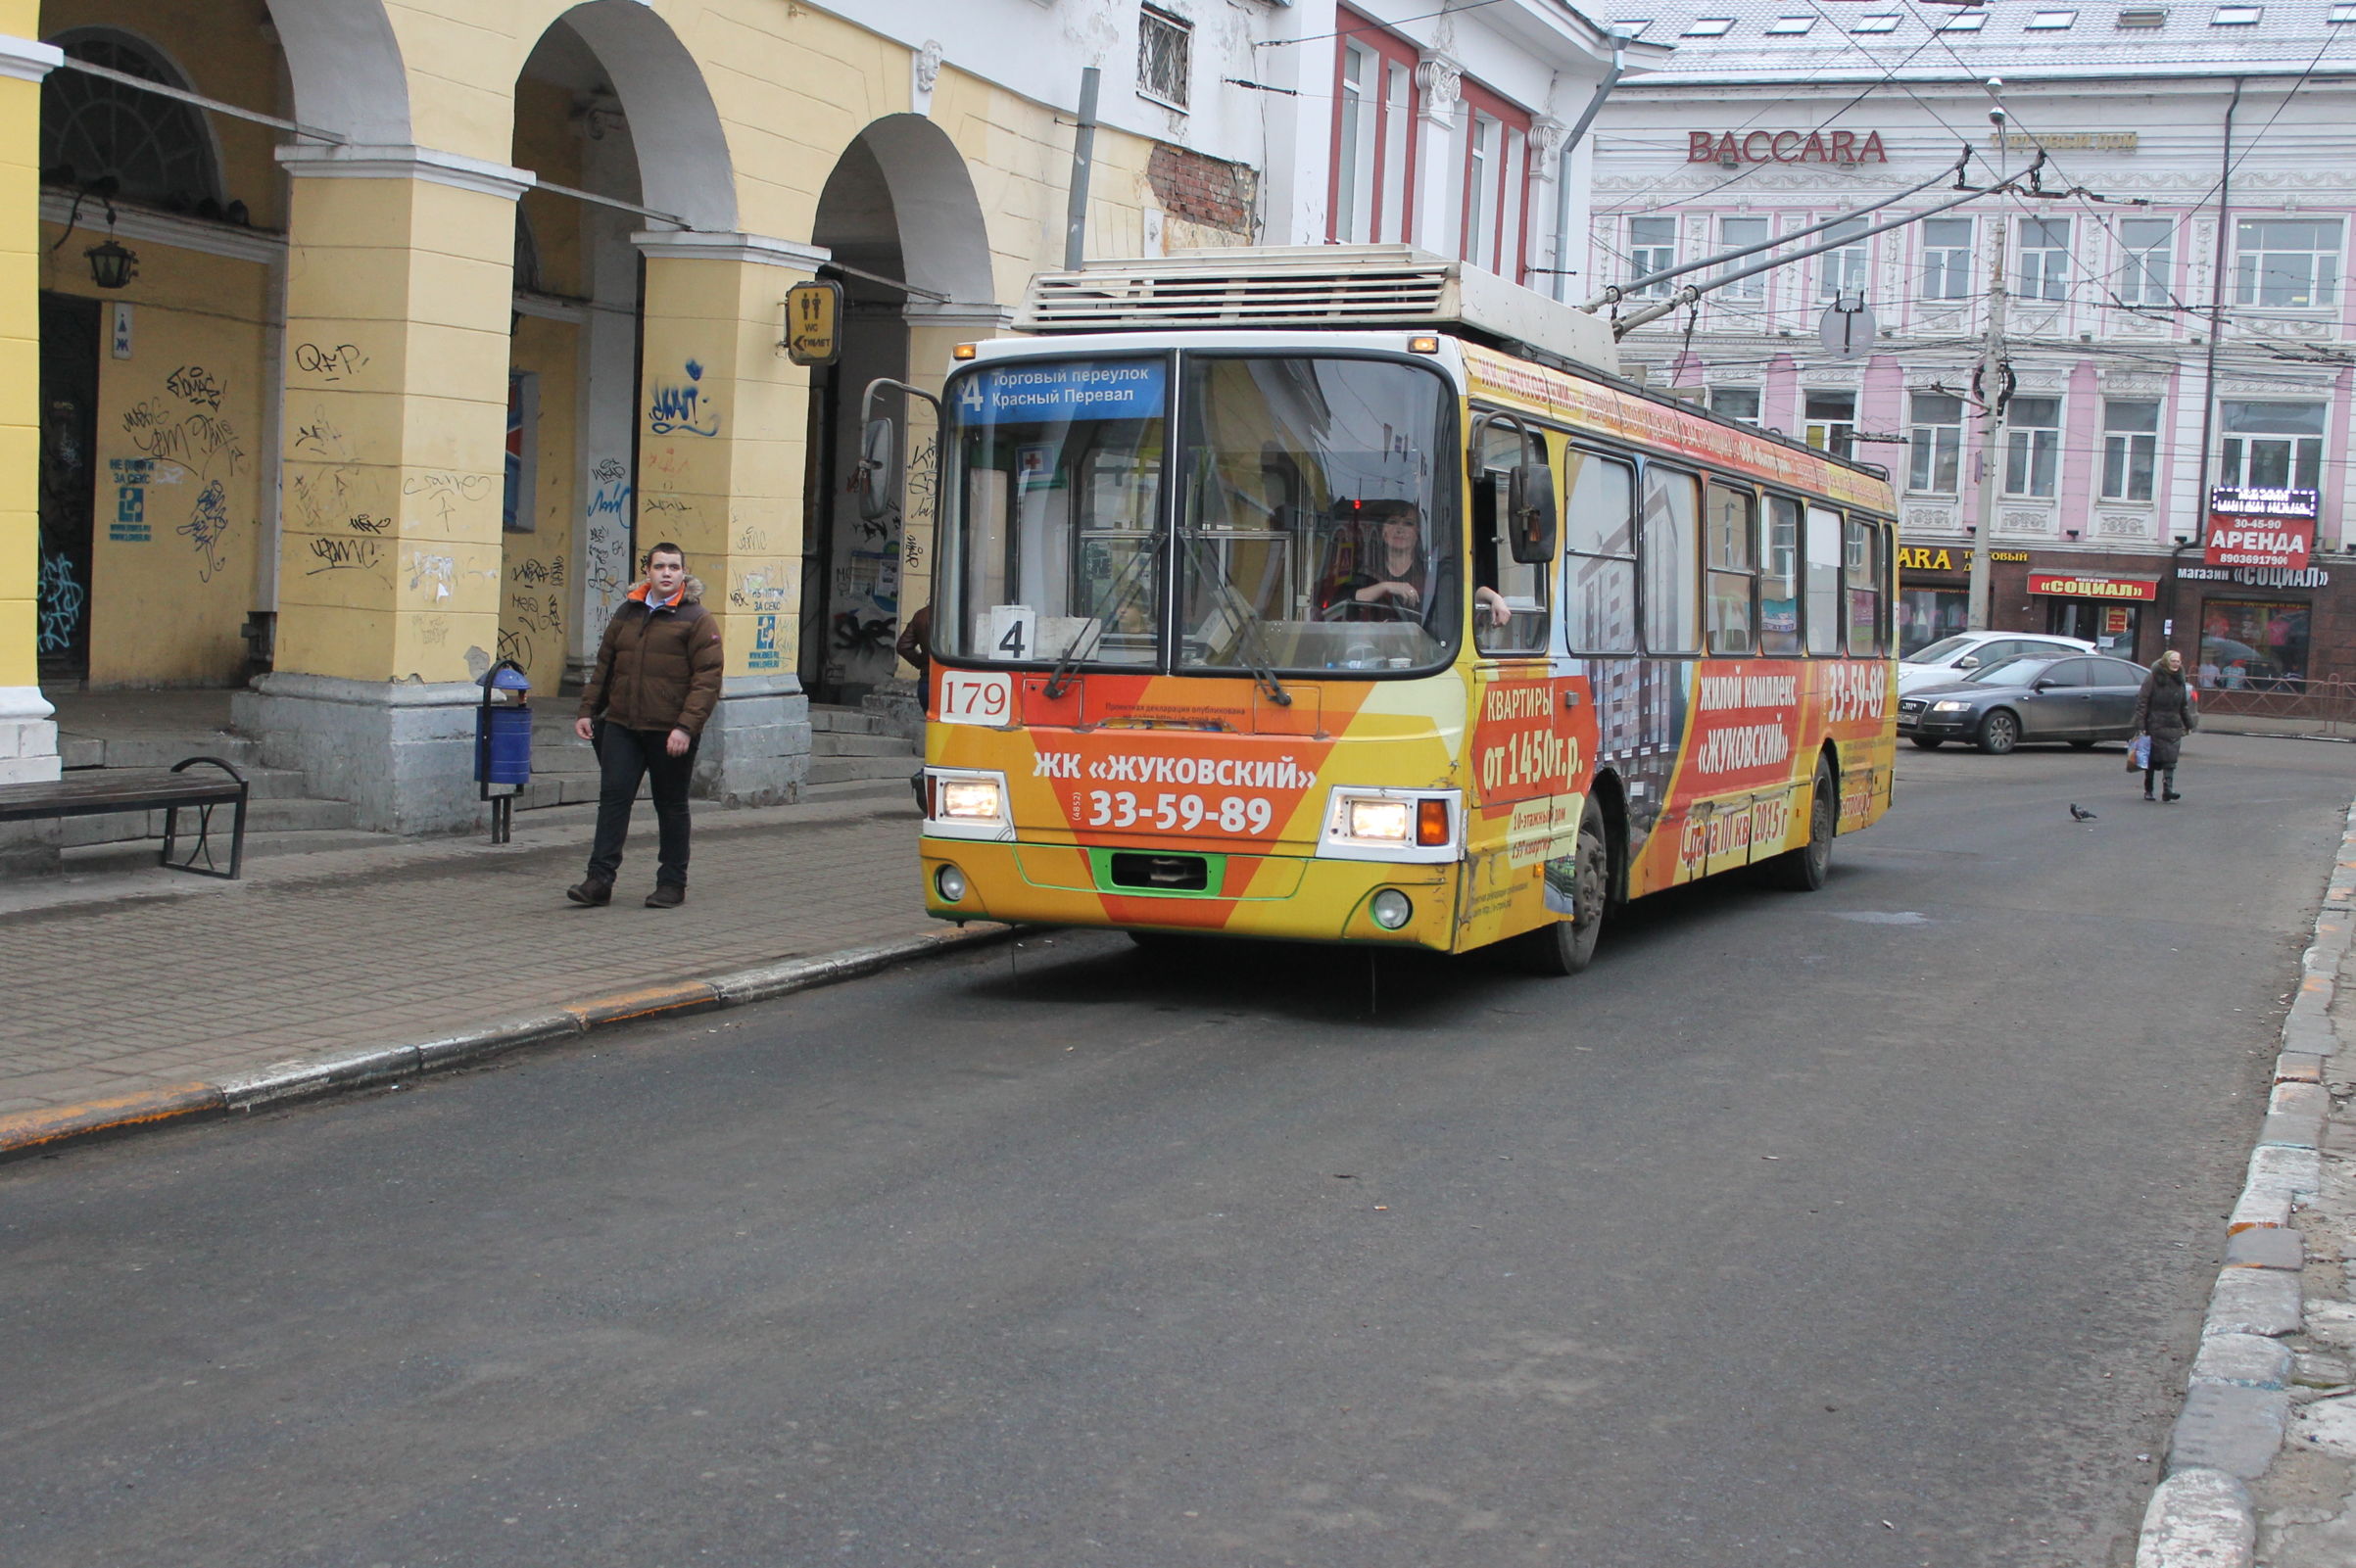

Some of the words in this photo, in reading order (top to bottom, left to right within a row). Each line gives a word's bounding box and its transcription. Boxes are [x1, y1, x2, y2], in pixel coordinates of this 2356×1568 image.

[1687, 130, 1888, 164] BACCARA
[116, 338, 128, 352] Ж
[962, 374, 984, 412] 4
[991, 369, 1067, 389] Торговый
[1072, 368, 1149, 385] переулок
[992, 390, 1060, 409] Красный
[1064, 389, 1134, 406] Перевал
[2235, 519, 2282, 530] 30-45-90
[2210, 530, 2305, 555] АРЕНДА
[2041, 580, 2142, 597] «СОЦИАЛ»
[2177, 567, 2230, 581] магазин
[2234, 566, 2329, 589] «СОЦИАЛ»
[999, 620, 1026, 659] 4
[945, 681, 1007, 716] 179
[1487, 687, 1553, 722] КВАРТИРЫ
[1828, 663, 1885, 723] 33-59-89
[1698, 713, 1789, 775] «ЖУКОВСКИЙ»
[1033, 752, 1082, 780] ЖК
[1088, 755, 1318, 789] «ЖУКОВСКИЙ»
[1483, 746, 1506, 790] от
[1072, 791, 1082, 821] (4852)
[1088, 790, 1272, 835] 33-59-89
[1755, 799, 1781, 844] 2015
